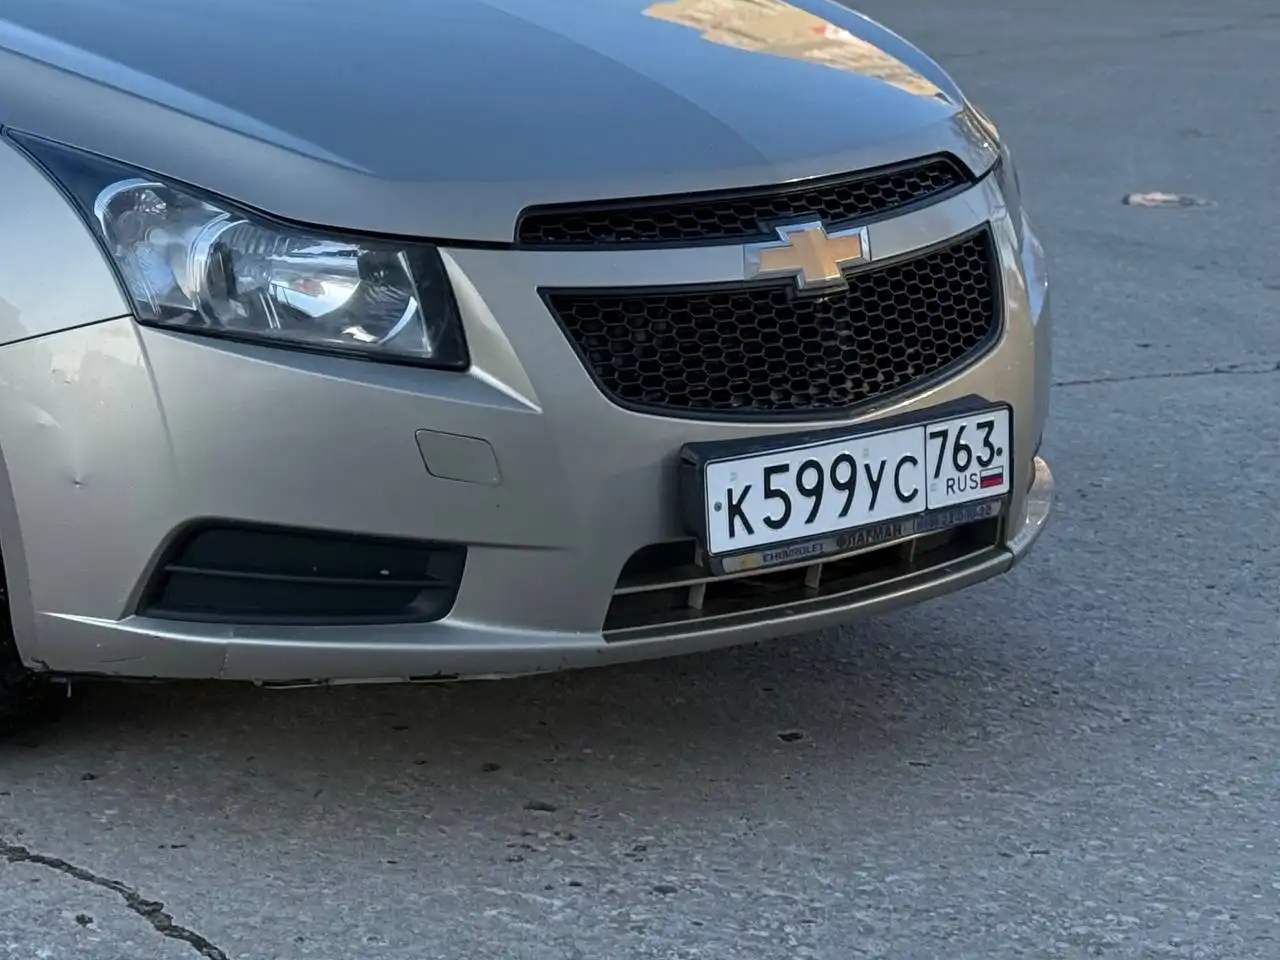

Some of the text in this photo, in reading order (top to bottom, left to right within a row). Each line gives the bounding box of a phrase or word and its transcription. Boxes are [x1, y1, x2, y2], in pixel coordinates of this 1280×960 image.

[726, 420, 995, 539] К599УС 763
[946, 476, 980, 496] RUS
